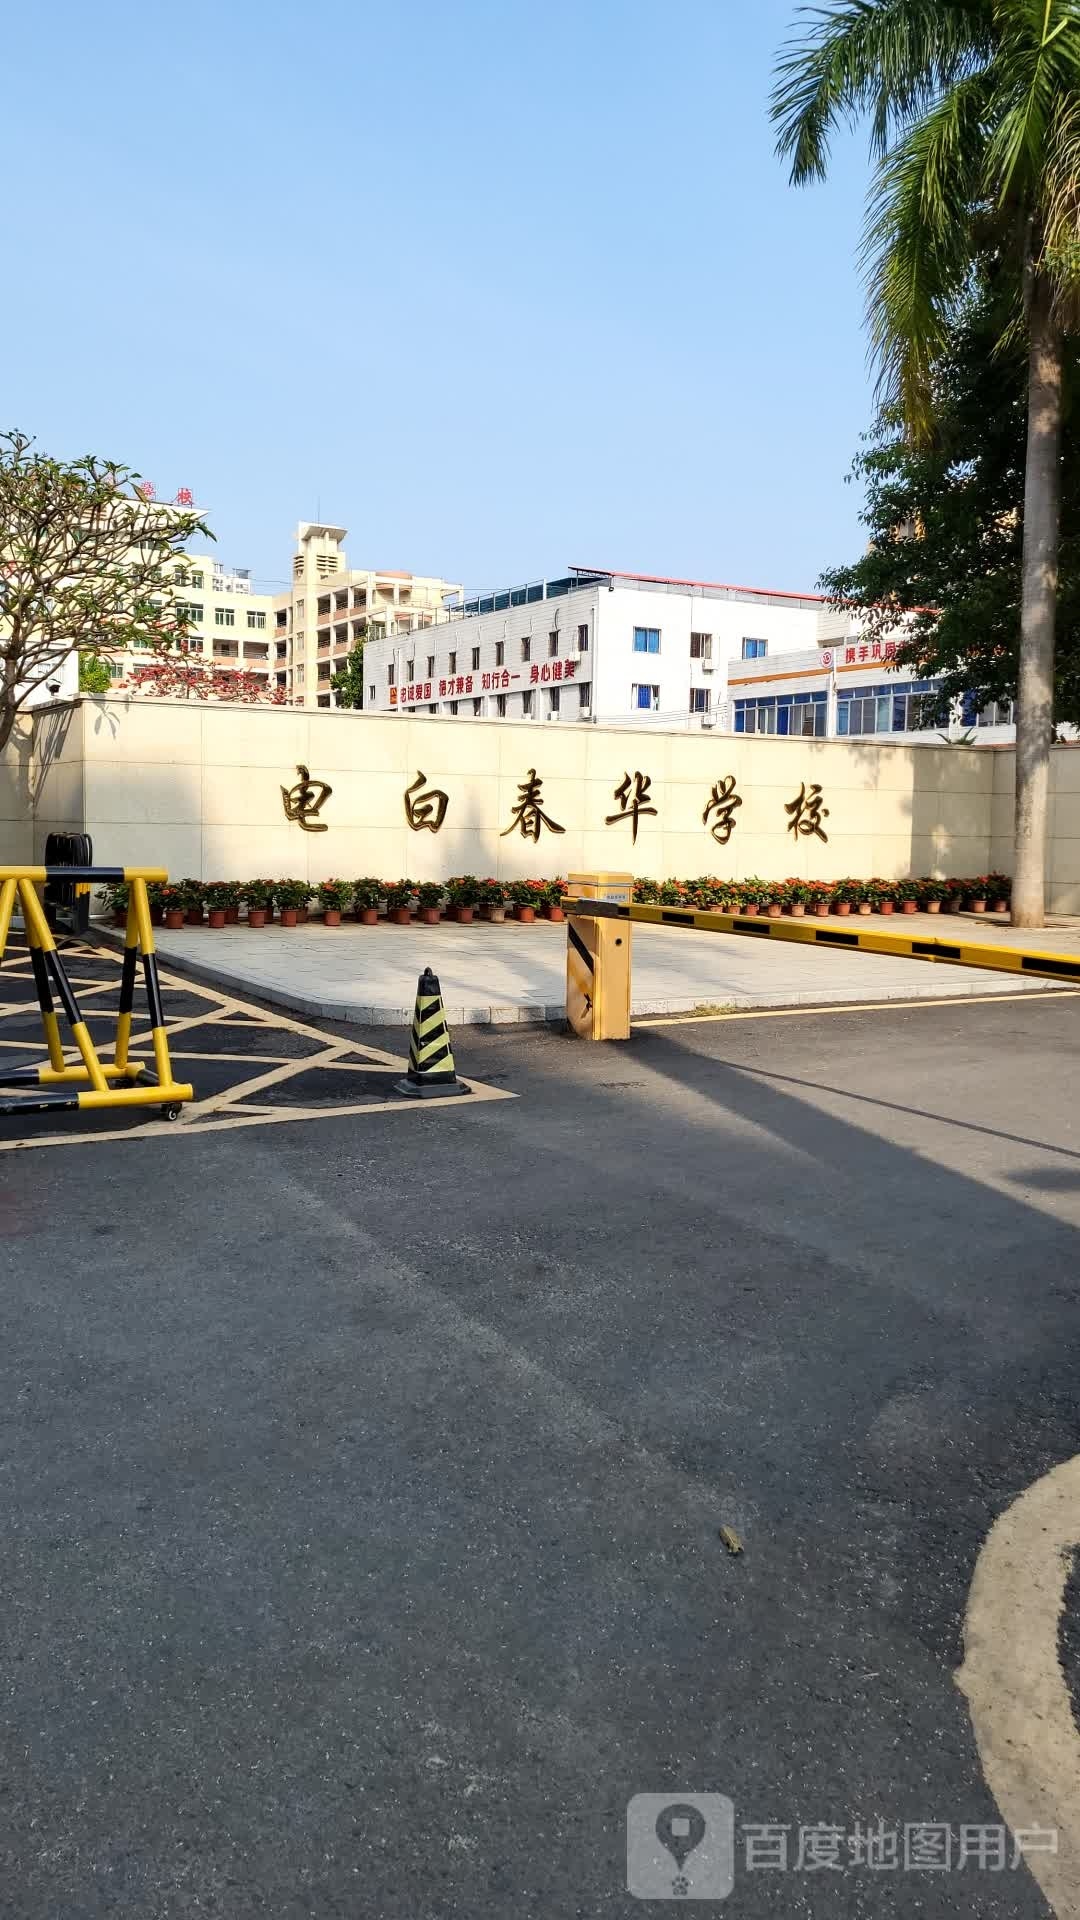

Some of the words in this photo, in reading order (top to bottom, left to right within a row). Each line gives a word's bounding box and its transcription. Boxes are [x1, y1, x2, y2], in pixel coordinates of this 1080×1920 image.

[400, 683, 431, 703] 忠诚爱国
[439, 675, 473, 697] 德才兼备
[482, 669, 520, 690] 知行合一
[529, 659, 577, 684] 身心健美
[279, 764, 830, 845] 电白春华学校
